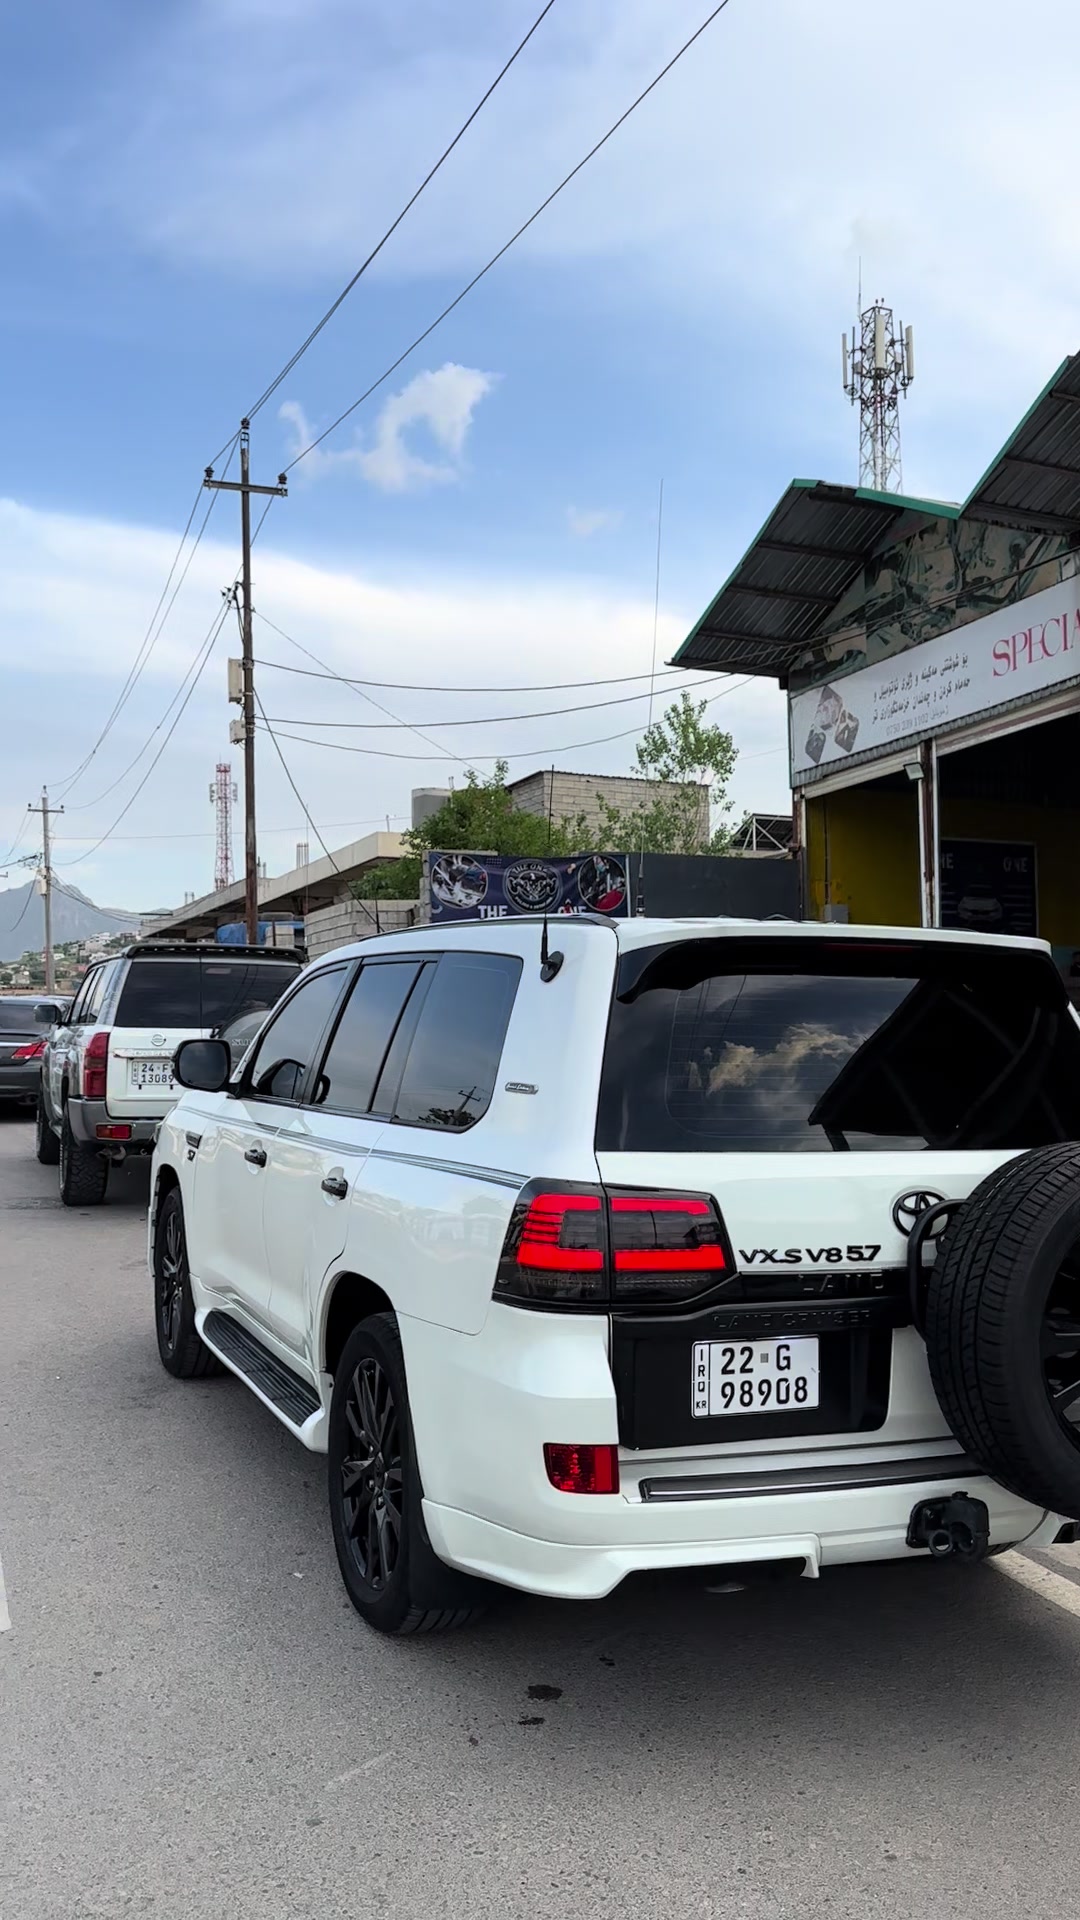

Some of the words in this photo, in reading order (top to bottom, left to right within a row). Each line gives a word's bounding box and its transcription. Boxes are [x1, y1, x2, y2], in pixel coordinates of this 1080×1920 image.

[478, 905, 508, 919] THE
[142, 1064, 154, 1072] 24
[162, 1064, 168, 1072] F
[141, 1074, 174, 1083] 13089
[846, 1244, 882, 1261] 57
[721, 1346, 754, 1375] 22
[776, 1344, 791, 1371] G
[721, 1376, 808, 1409] 98908
[696, 1400, 707, 1409] KR
